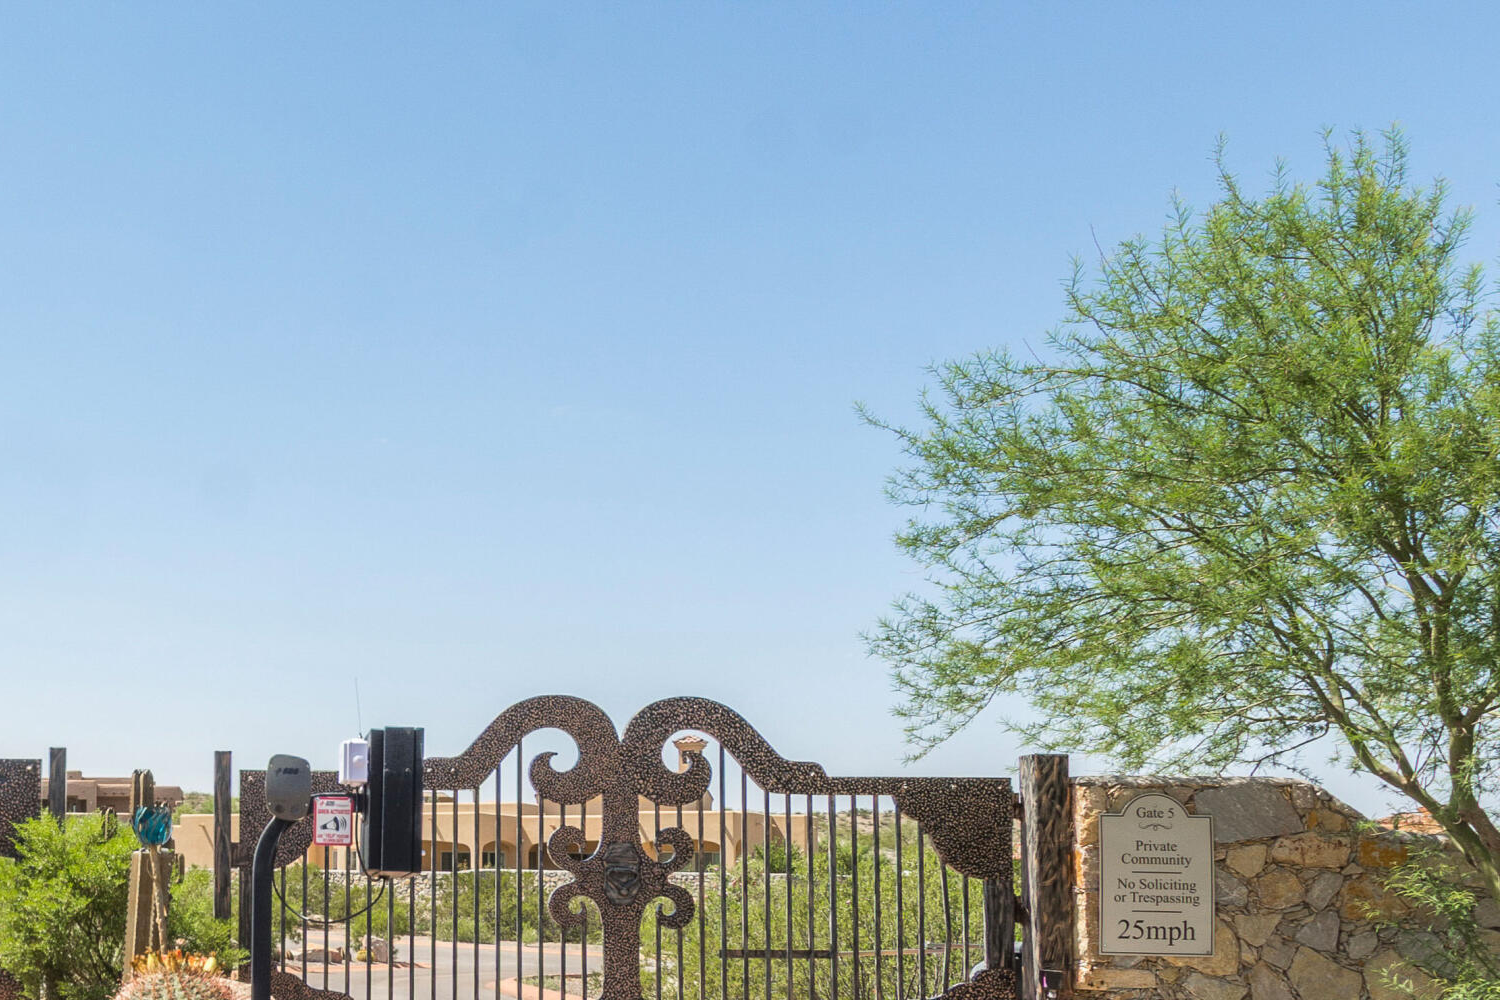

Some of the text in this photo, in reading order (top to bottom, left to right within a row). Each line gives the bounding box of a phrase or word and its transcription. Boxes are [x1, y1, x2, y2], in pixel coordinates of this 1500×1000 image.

[1136, 807, 1175, 819] Gate 5
[1135, 840, 1178, 852] Private
[1121, 853, 1192, 868] Community
[1117, 878, 1197, 893] No Soliciting
[1114, 892, 1201, 906] or Trespassing
[1117, 919, 1196, 946] 25mph
